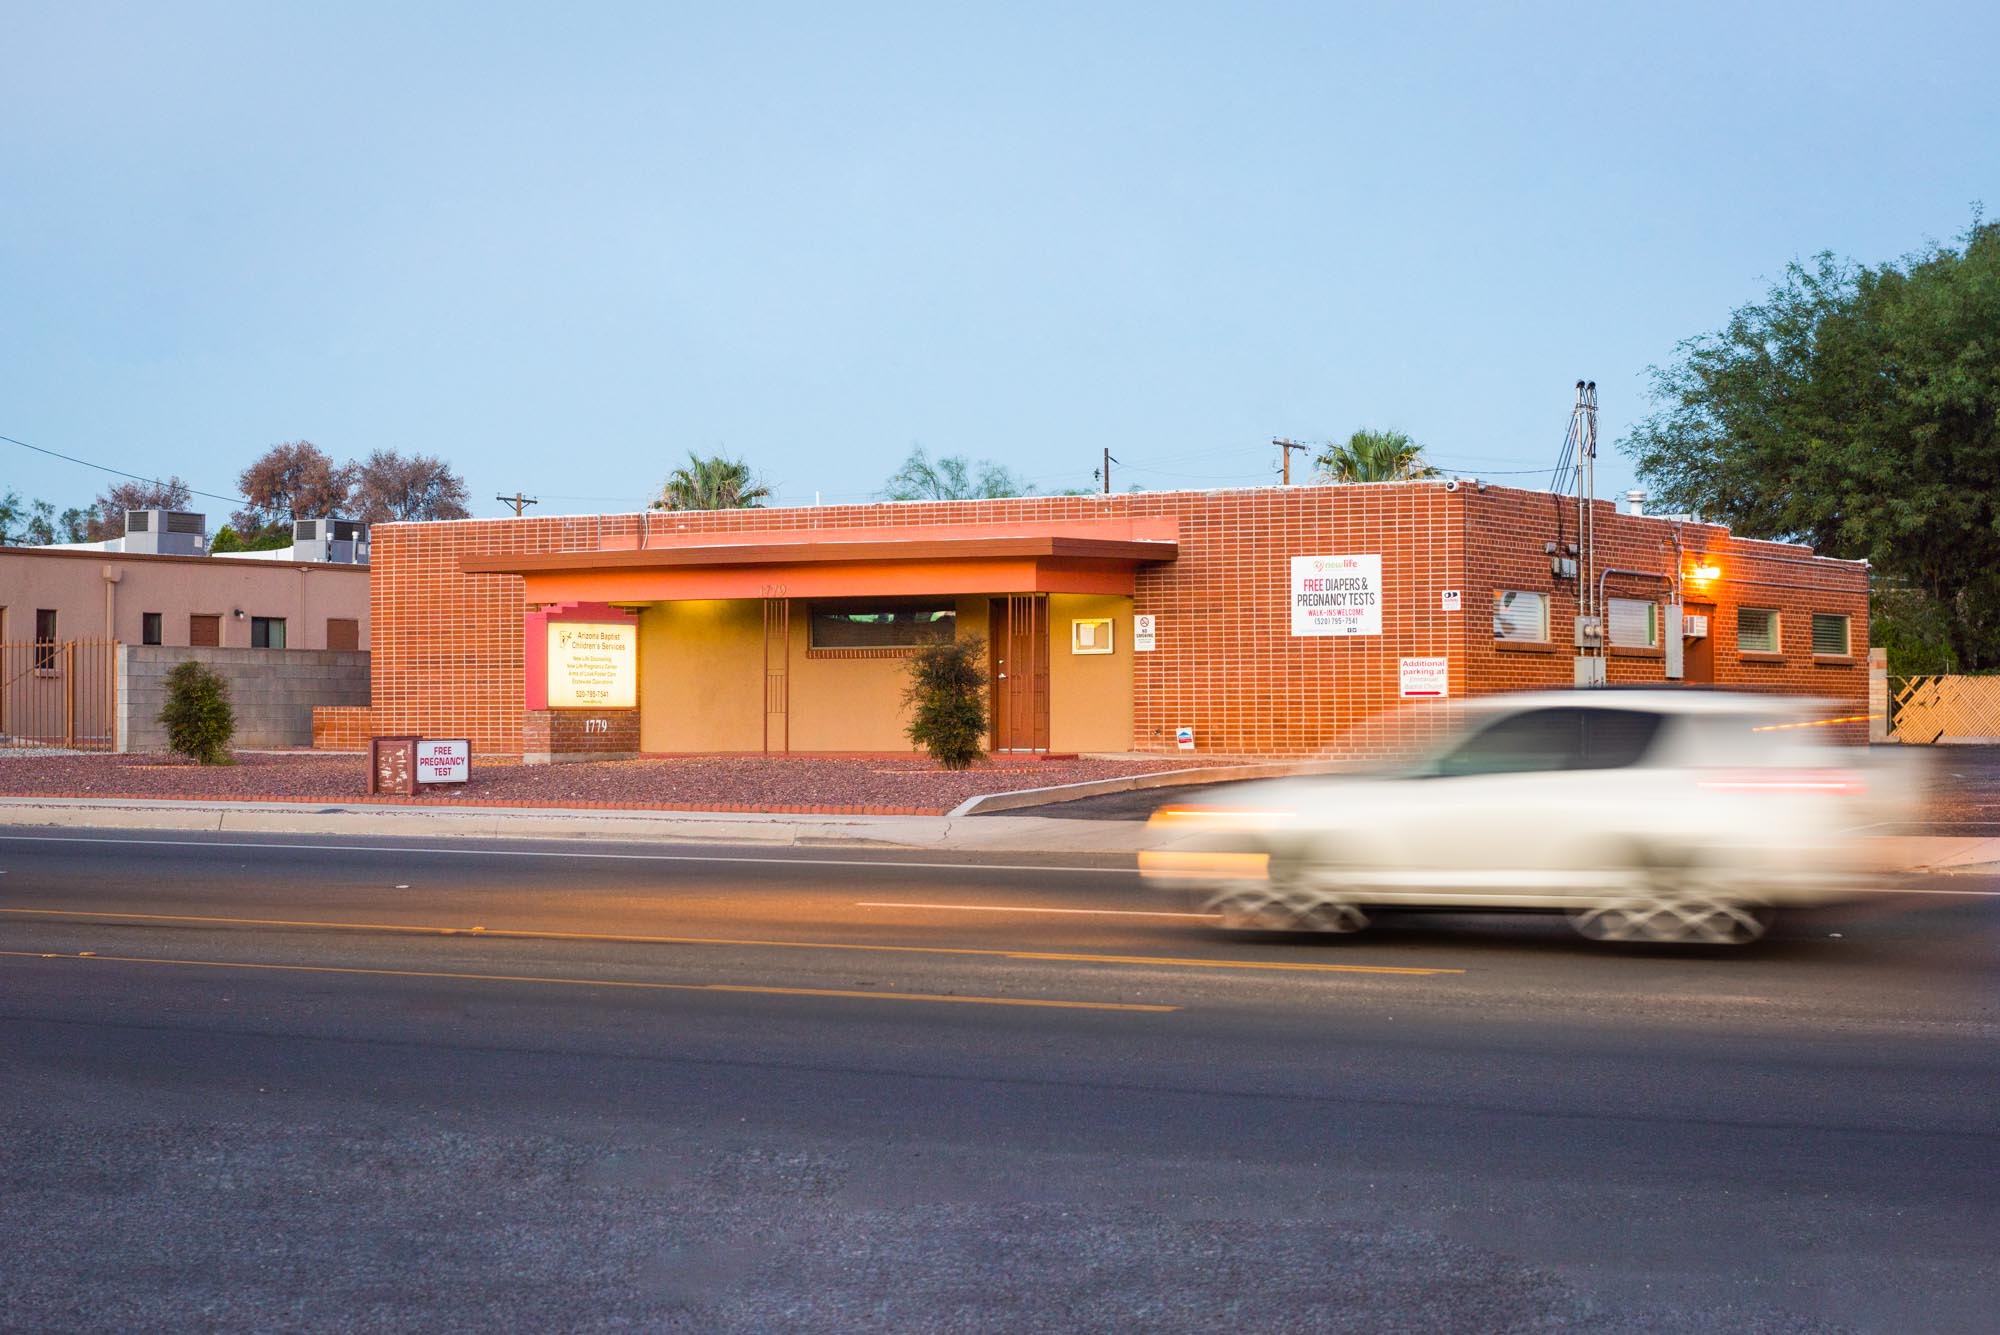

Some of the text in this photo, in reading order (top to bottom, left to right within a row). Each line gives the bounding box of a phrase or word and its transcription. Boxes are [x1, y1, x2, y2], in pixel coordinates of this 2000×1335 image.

[1303, 576, 1368, 592] FREE DIAPERS &
[1297, 592, 1375, 607] PREGNANCY TESTS
[1336, 608, 1364, 616] WELCOME
[1314, 617, 1358, 625] (520) 795-7541
[577, 631, 620, 641] Arizona Baptist
[572, 641, 625, 651] Children's Services
[1403, 667, 1434, 676] parking
[575, 690, 609, 698] 520-795-7541
[585, 719, 608, 733] 1779
[433, 746, 452, 755] FREE
[420, 757, 465, 766] PREGNANCY
[434, 767, 452, 776] TEST
